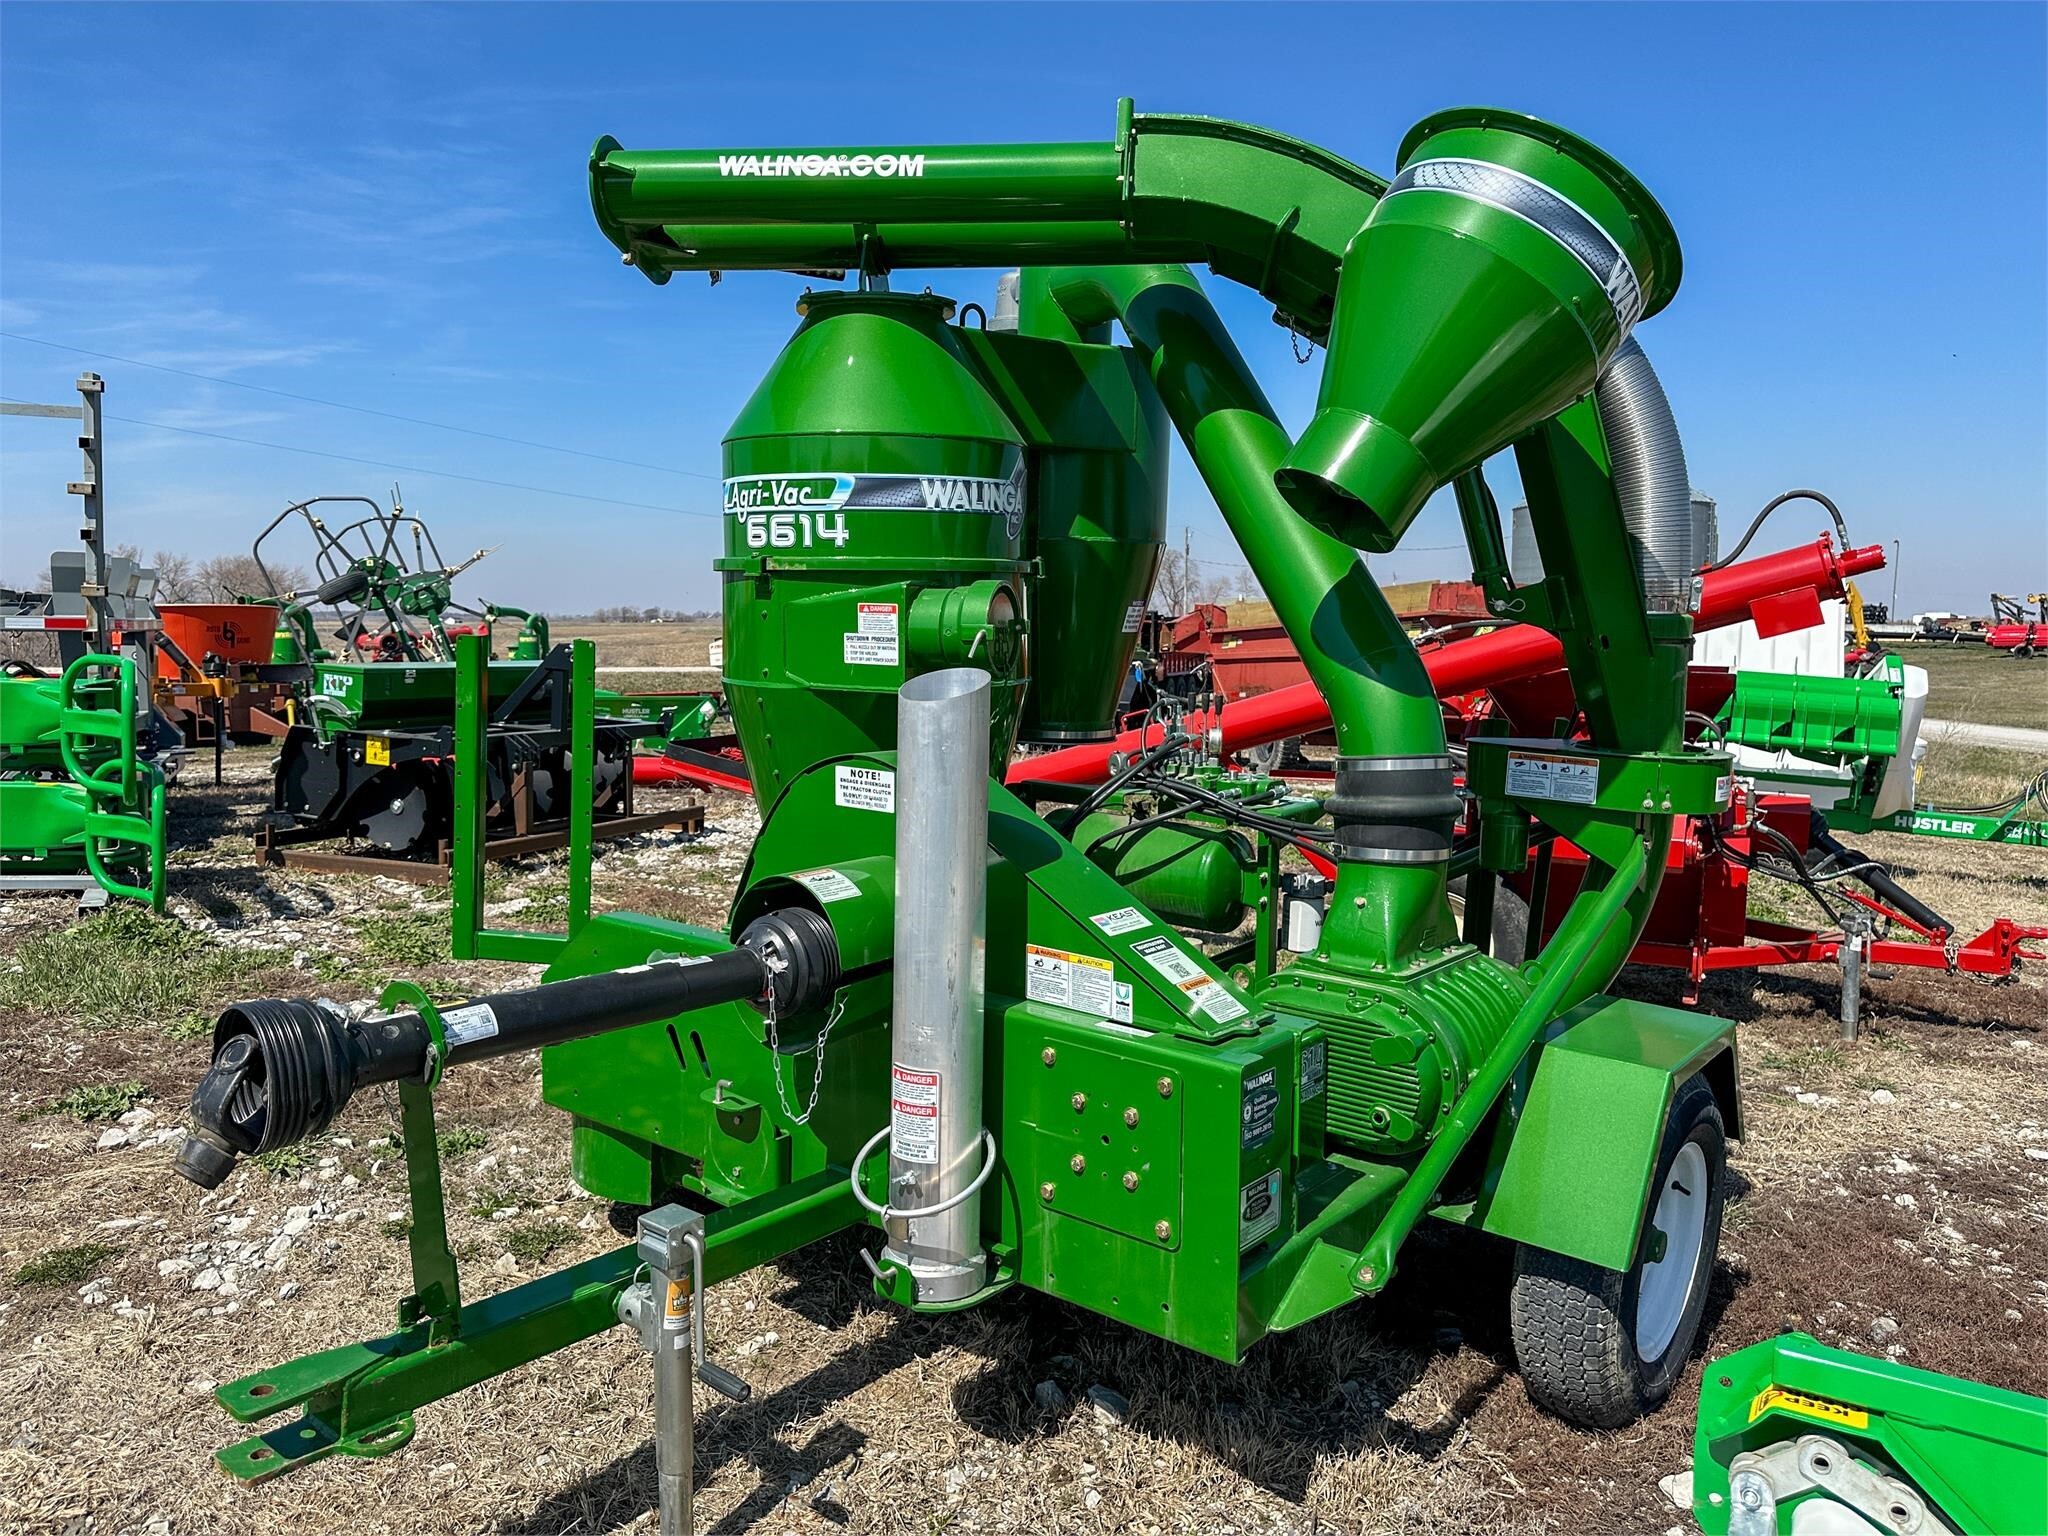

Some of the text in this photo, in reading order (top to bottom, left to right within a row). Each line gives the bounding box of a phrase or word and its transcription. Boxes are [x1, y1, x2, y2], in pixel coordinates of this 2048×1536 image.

[1604, 255, 1640, 339] WAL
[731, 478, 812, 524] Agri-Vac
[919, 477, 1023, 514] WALINGA
[746, 512, 850, 549] 6614
[869, 604, 894, 613] DANGER
[850, 769, 881, 781] NOTE!
[850, 785, 872, 793] TRACTOR
[872, 788, 892, 796] CLUTCH
[864, 780, 891, 789] DISENGAGE
[1894, 815, 1976, 835] HUSTLER
[1106, 908, 1137, 921] KEAST
[1039, 950, 1062, 960] WARNING
[1082, 958, 1104, 967] CAUTION
[901, 1073, 933, 1084] DANGER
[1246, 1071, 1274, 1091] WALINGA
[1253, 1094, 1268, 1105] Quality
[1253, 1096, 1278, 1112] Management
[901, 1104, 933, 1116] DANGER
[1252, 1121, 1272, 1137] 9001:2015
[1784, 1397, 1849, 1417] KEEP
